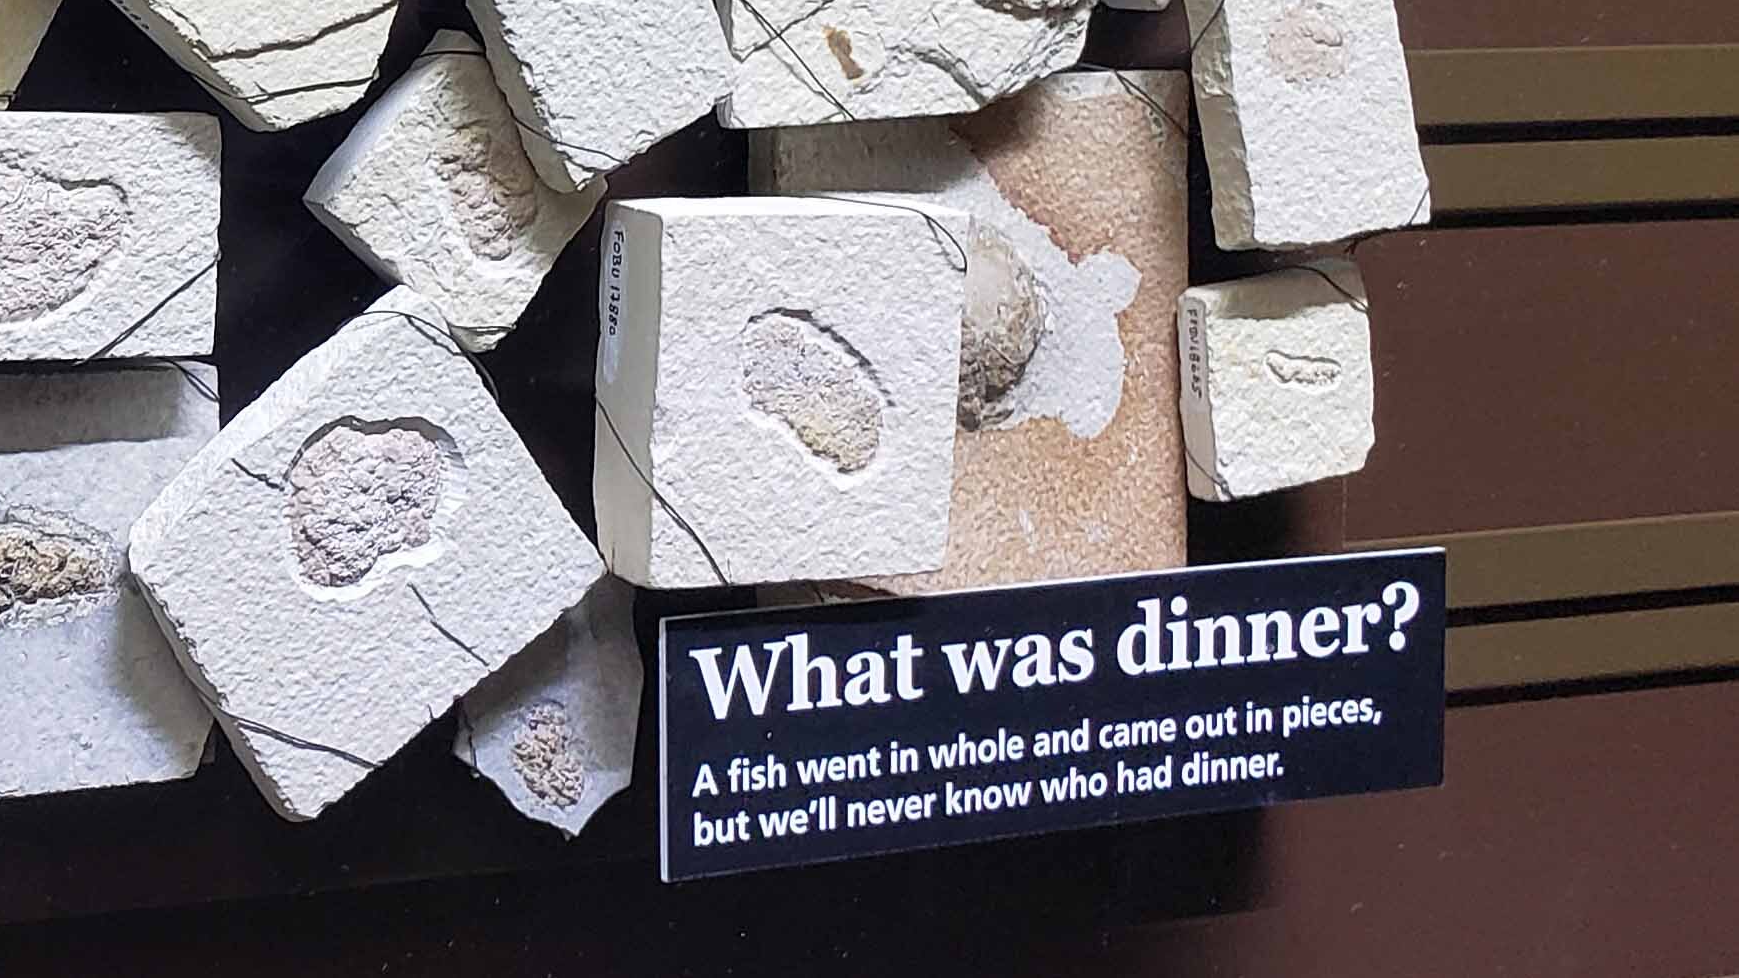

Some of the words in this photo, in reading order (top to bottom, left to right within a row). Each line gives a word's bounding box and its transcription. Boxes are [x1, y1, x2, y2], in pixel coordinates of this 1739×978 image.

[611, 230, 625, 279] FOBU
[688, 632, 924, 720] What
[940, 628, 1095, 694] was
[1116, 581, 1420, 676] dinner?
[692, 763, 719, 798] A
[727, 754, 787, 793] fish
[796, 746, 882, 785] went
[890, 740, 919, 775] in
[927, 727, 1025, 770] whole
[1032, 717, 1090, 758] and
[1098, 717, 1177, 750] came
[1185, 706, 1238, 740] out
[1246, 701, 1273, 734] in
[1282, 695, 1382, 738] pieces,
[693, 810, 751, 847] but
[758, 795, 837, 838] we'll
[847, 792, 937, 828] never
[945, 781, 1032, 816] know
[1039, 766, 1108, 803] who
[1117, 754, 1173, 794] had
[1181, 751, 1284, 786] dinner.
